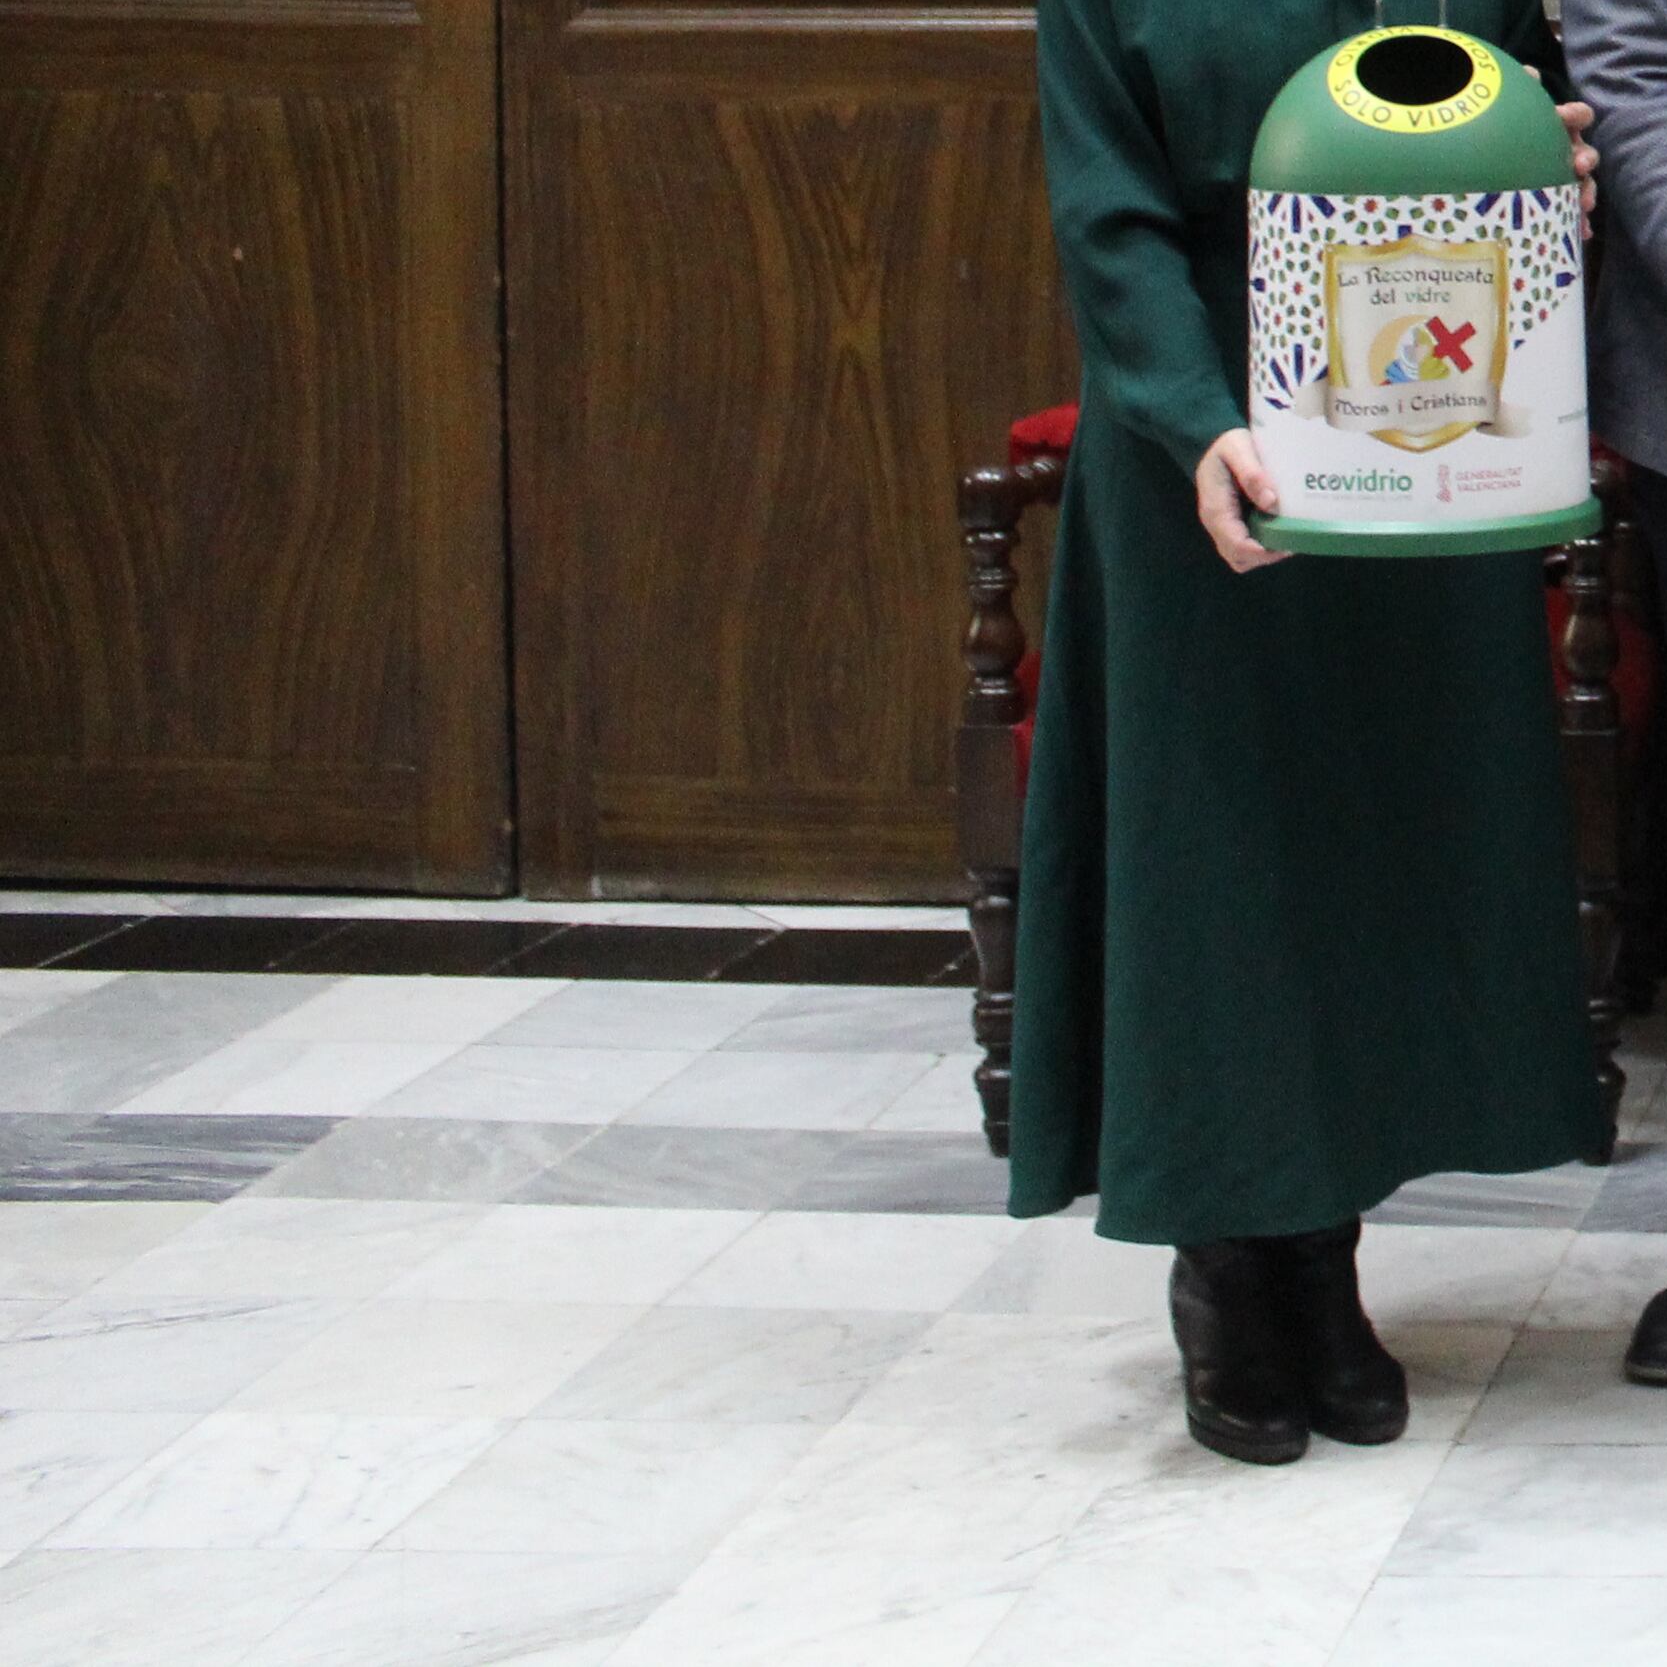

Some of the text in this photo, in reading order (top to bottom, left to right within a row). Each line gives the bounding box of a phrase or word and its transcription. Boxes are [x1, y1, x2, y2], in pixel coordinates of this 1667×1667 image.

[1334, 79, 1492, 127] SOLO VIDRIO
[1365, 266, 1494, 284] Reconquesta
[1370, 287, 1450, 305] del vidre
[1335, 398, 1389, 416] Moros
[1410, 395, 1488, 411] Cristians
[1304, 468, 1412, 492] ecovidrio
